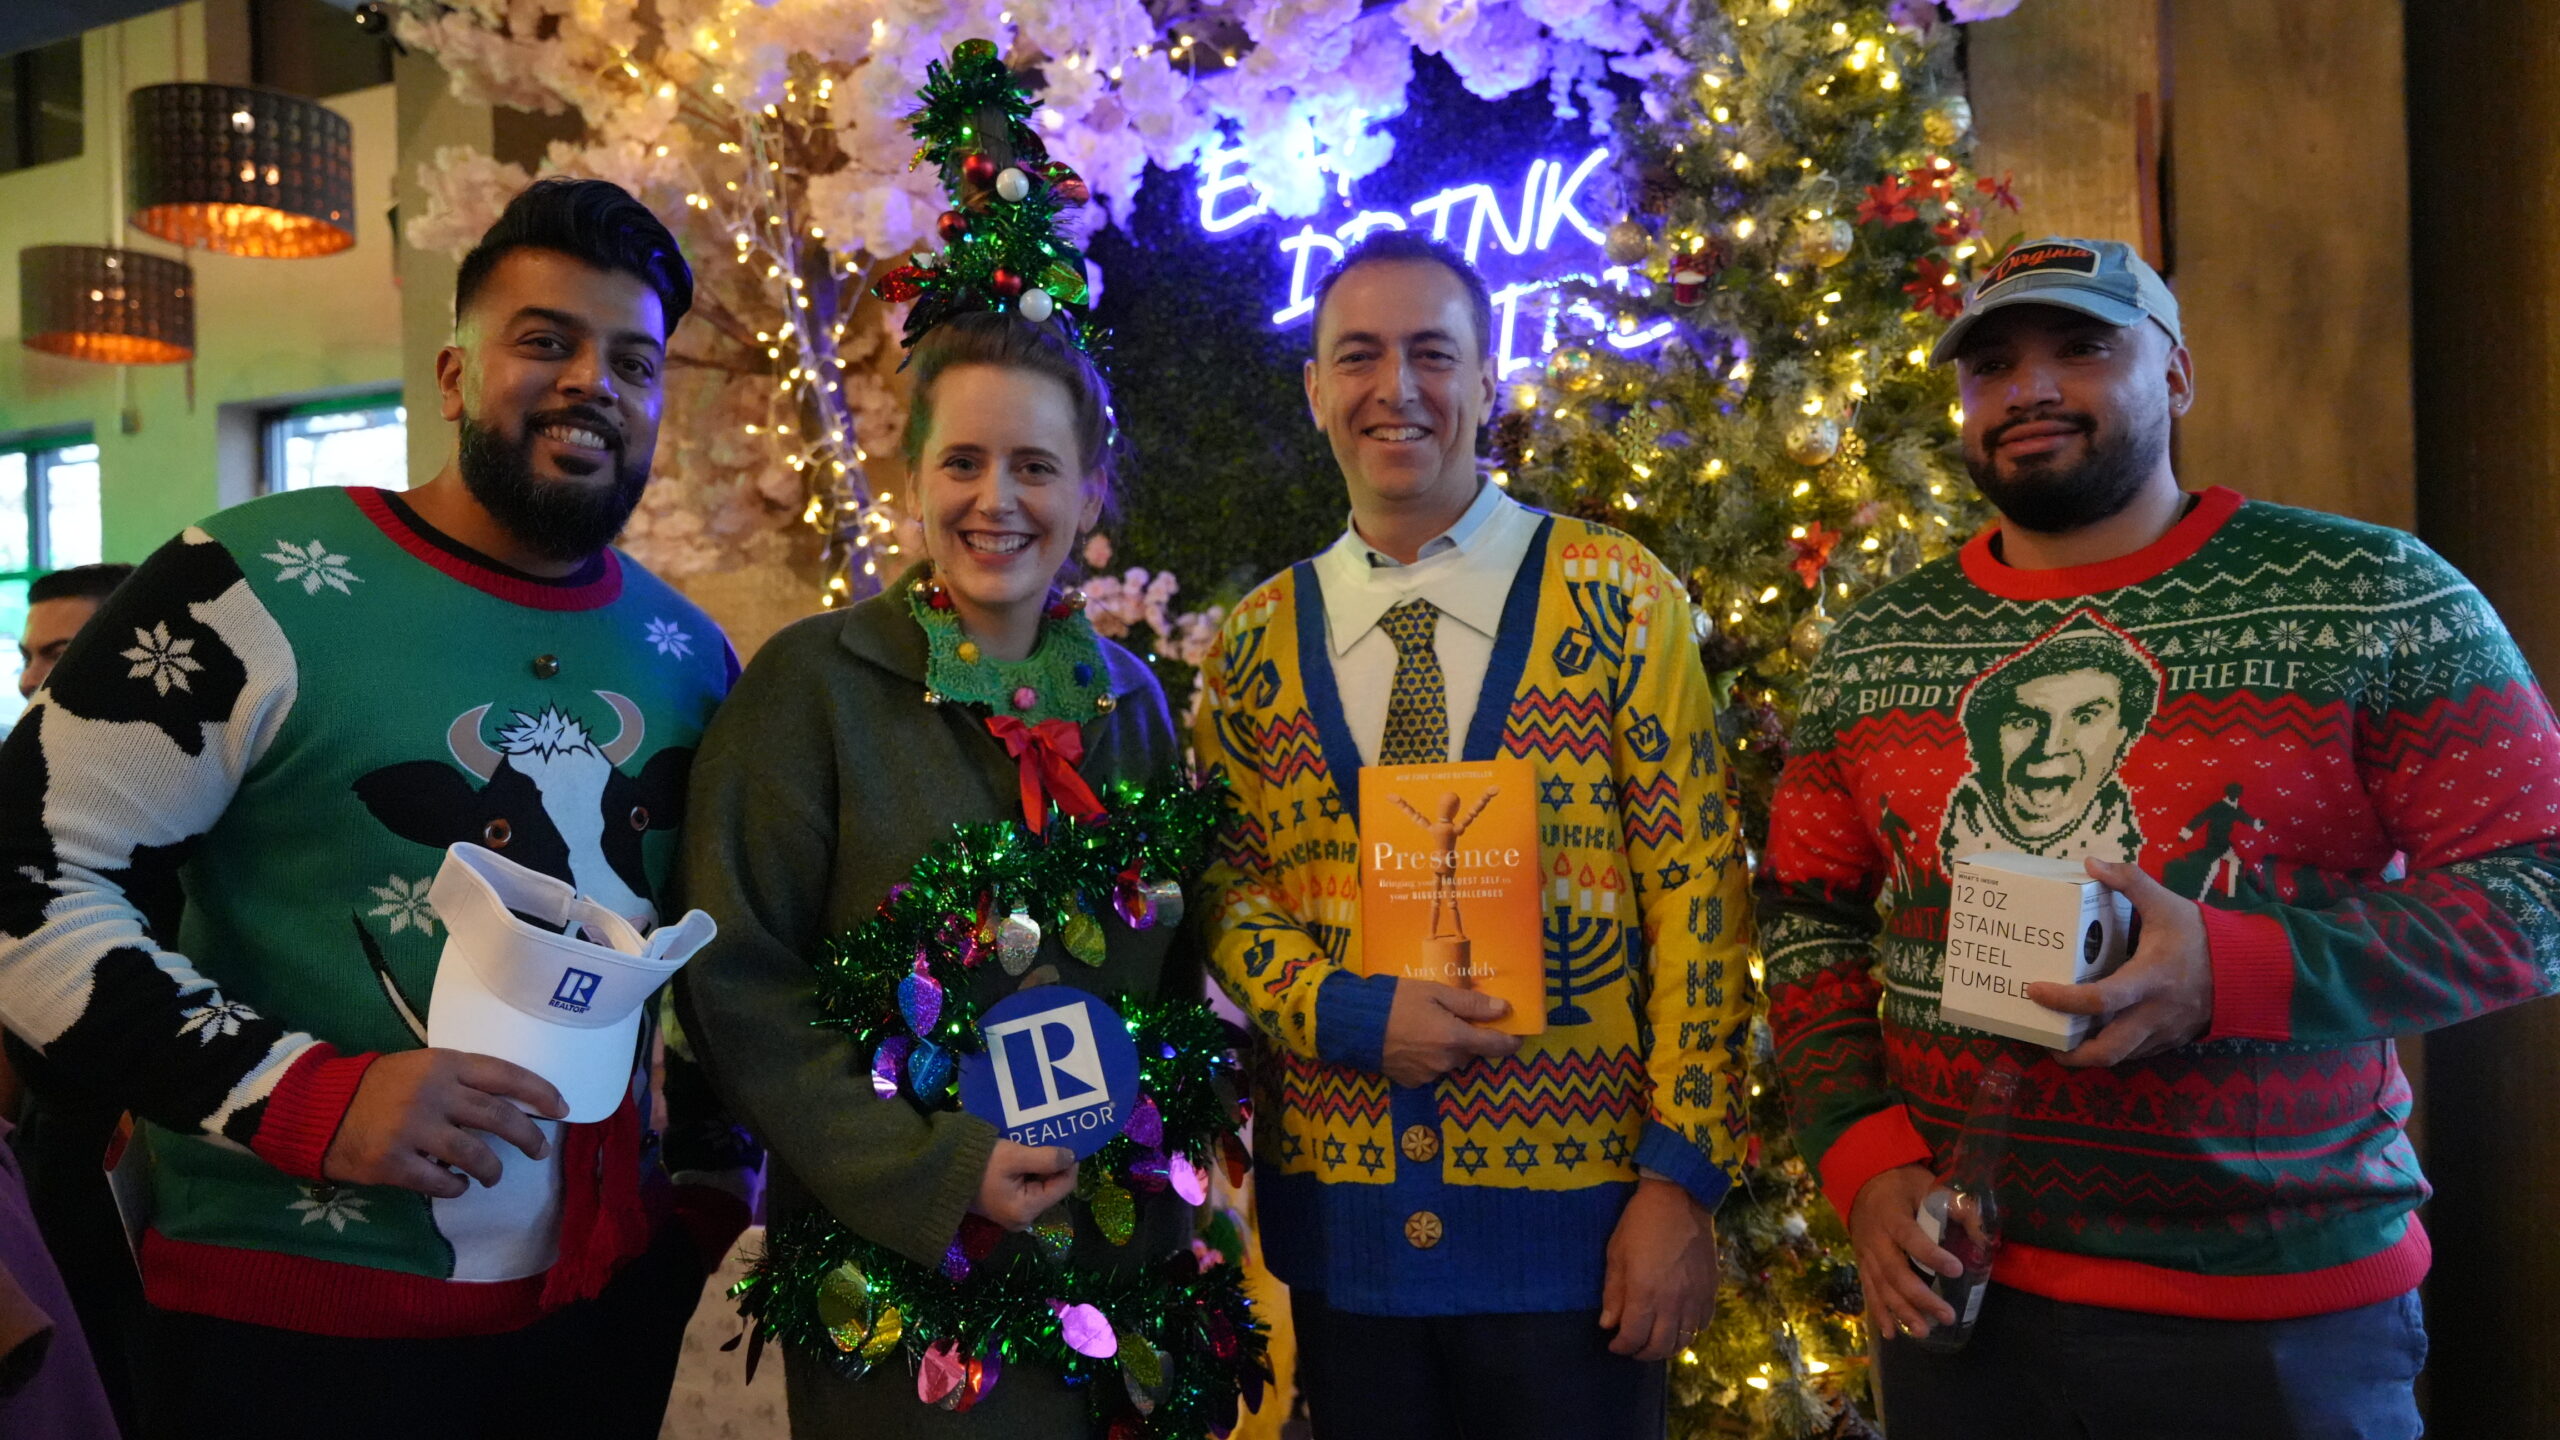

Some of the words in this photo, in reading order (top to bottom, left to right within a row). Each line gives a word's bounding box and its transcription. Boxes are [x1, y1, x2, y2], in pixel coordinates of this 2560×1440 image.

[1273, 149, 1607, 324] DINK
[1857, 684, 1964, 714] BUDDY
[2167, 661, 2237, 691] THE
[2242, 659, 2305, 690] ELF
[1374, 842, 1520, 871] Presence
[1412, 890, 1447, 900] BIGGEST
[1451, 888, 1504, 899] CHALLENGES
[1480, 876, 1500, 885] SELF
[1957, 885, 1975, 904] 12
[1982, 890, 2008, 910] OZ
[1953, 911, 2065, 950] STAINLESS
[1950, 938, 2012, 968] STEEL
[1403, 963, 1438, 981] Amy
[1444, 961, 1497, 981] Cuddy
[1949, 964, 2031, 1000] TUMBLE
